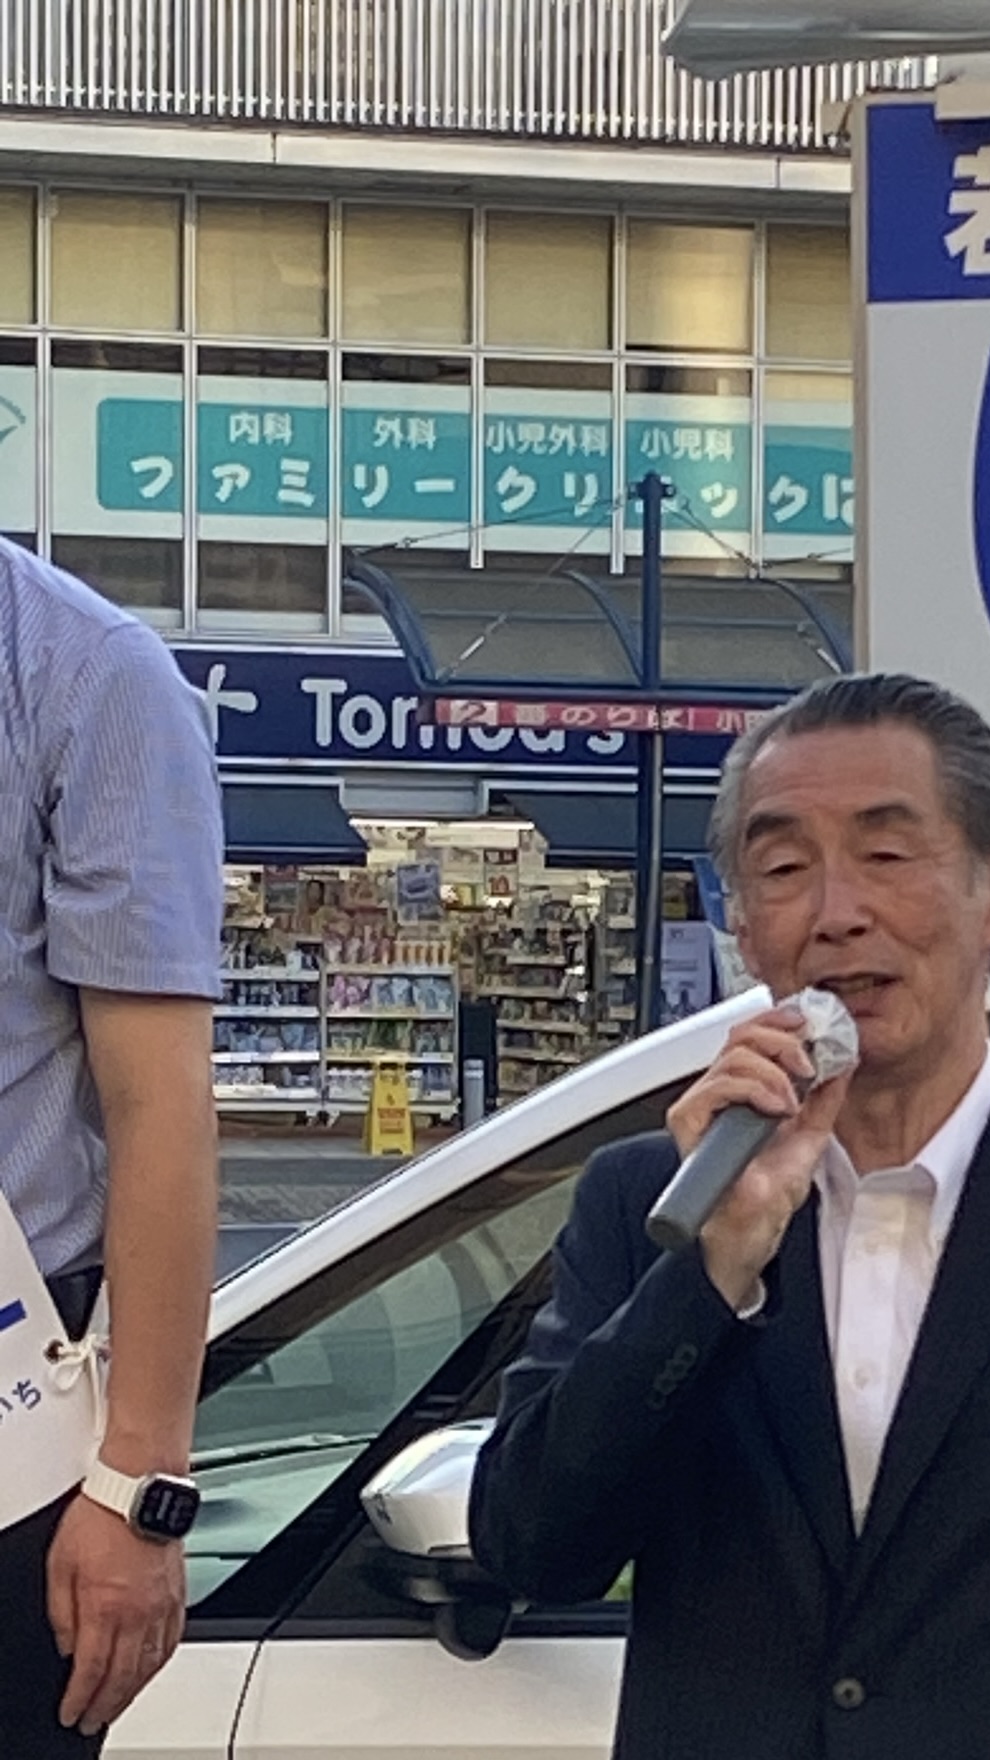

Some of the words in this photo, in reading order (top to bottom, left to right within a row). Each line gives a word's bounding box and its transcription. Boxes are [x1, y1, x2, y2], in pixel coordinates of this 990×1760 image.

[229, 411, 292, 446] 内科
[373, 416, 436, 450] 外科
[486, 420, 608, 457] 小児外科
[640, 427, 734, 462] 小児科
